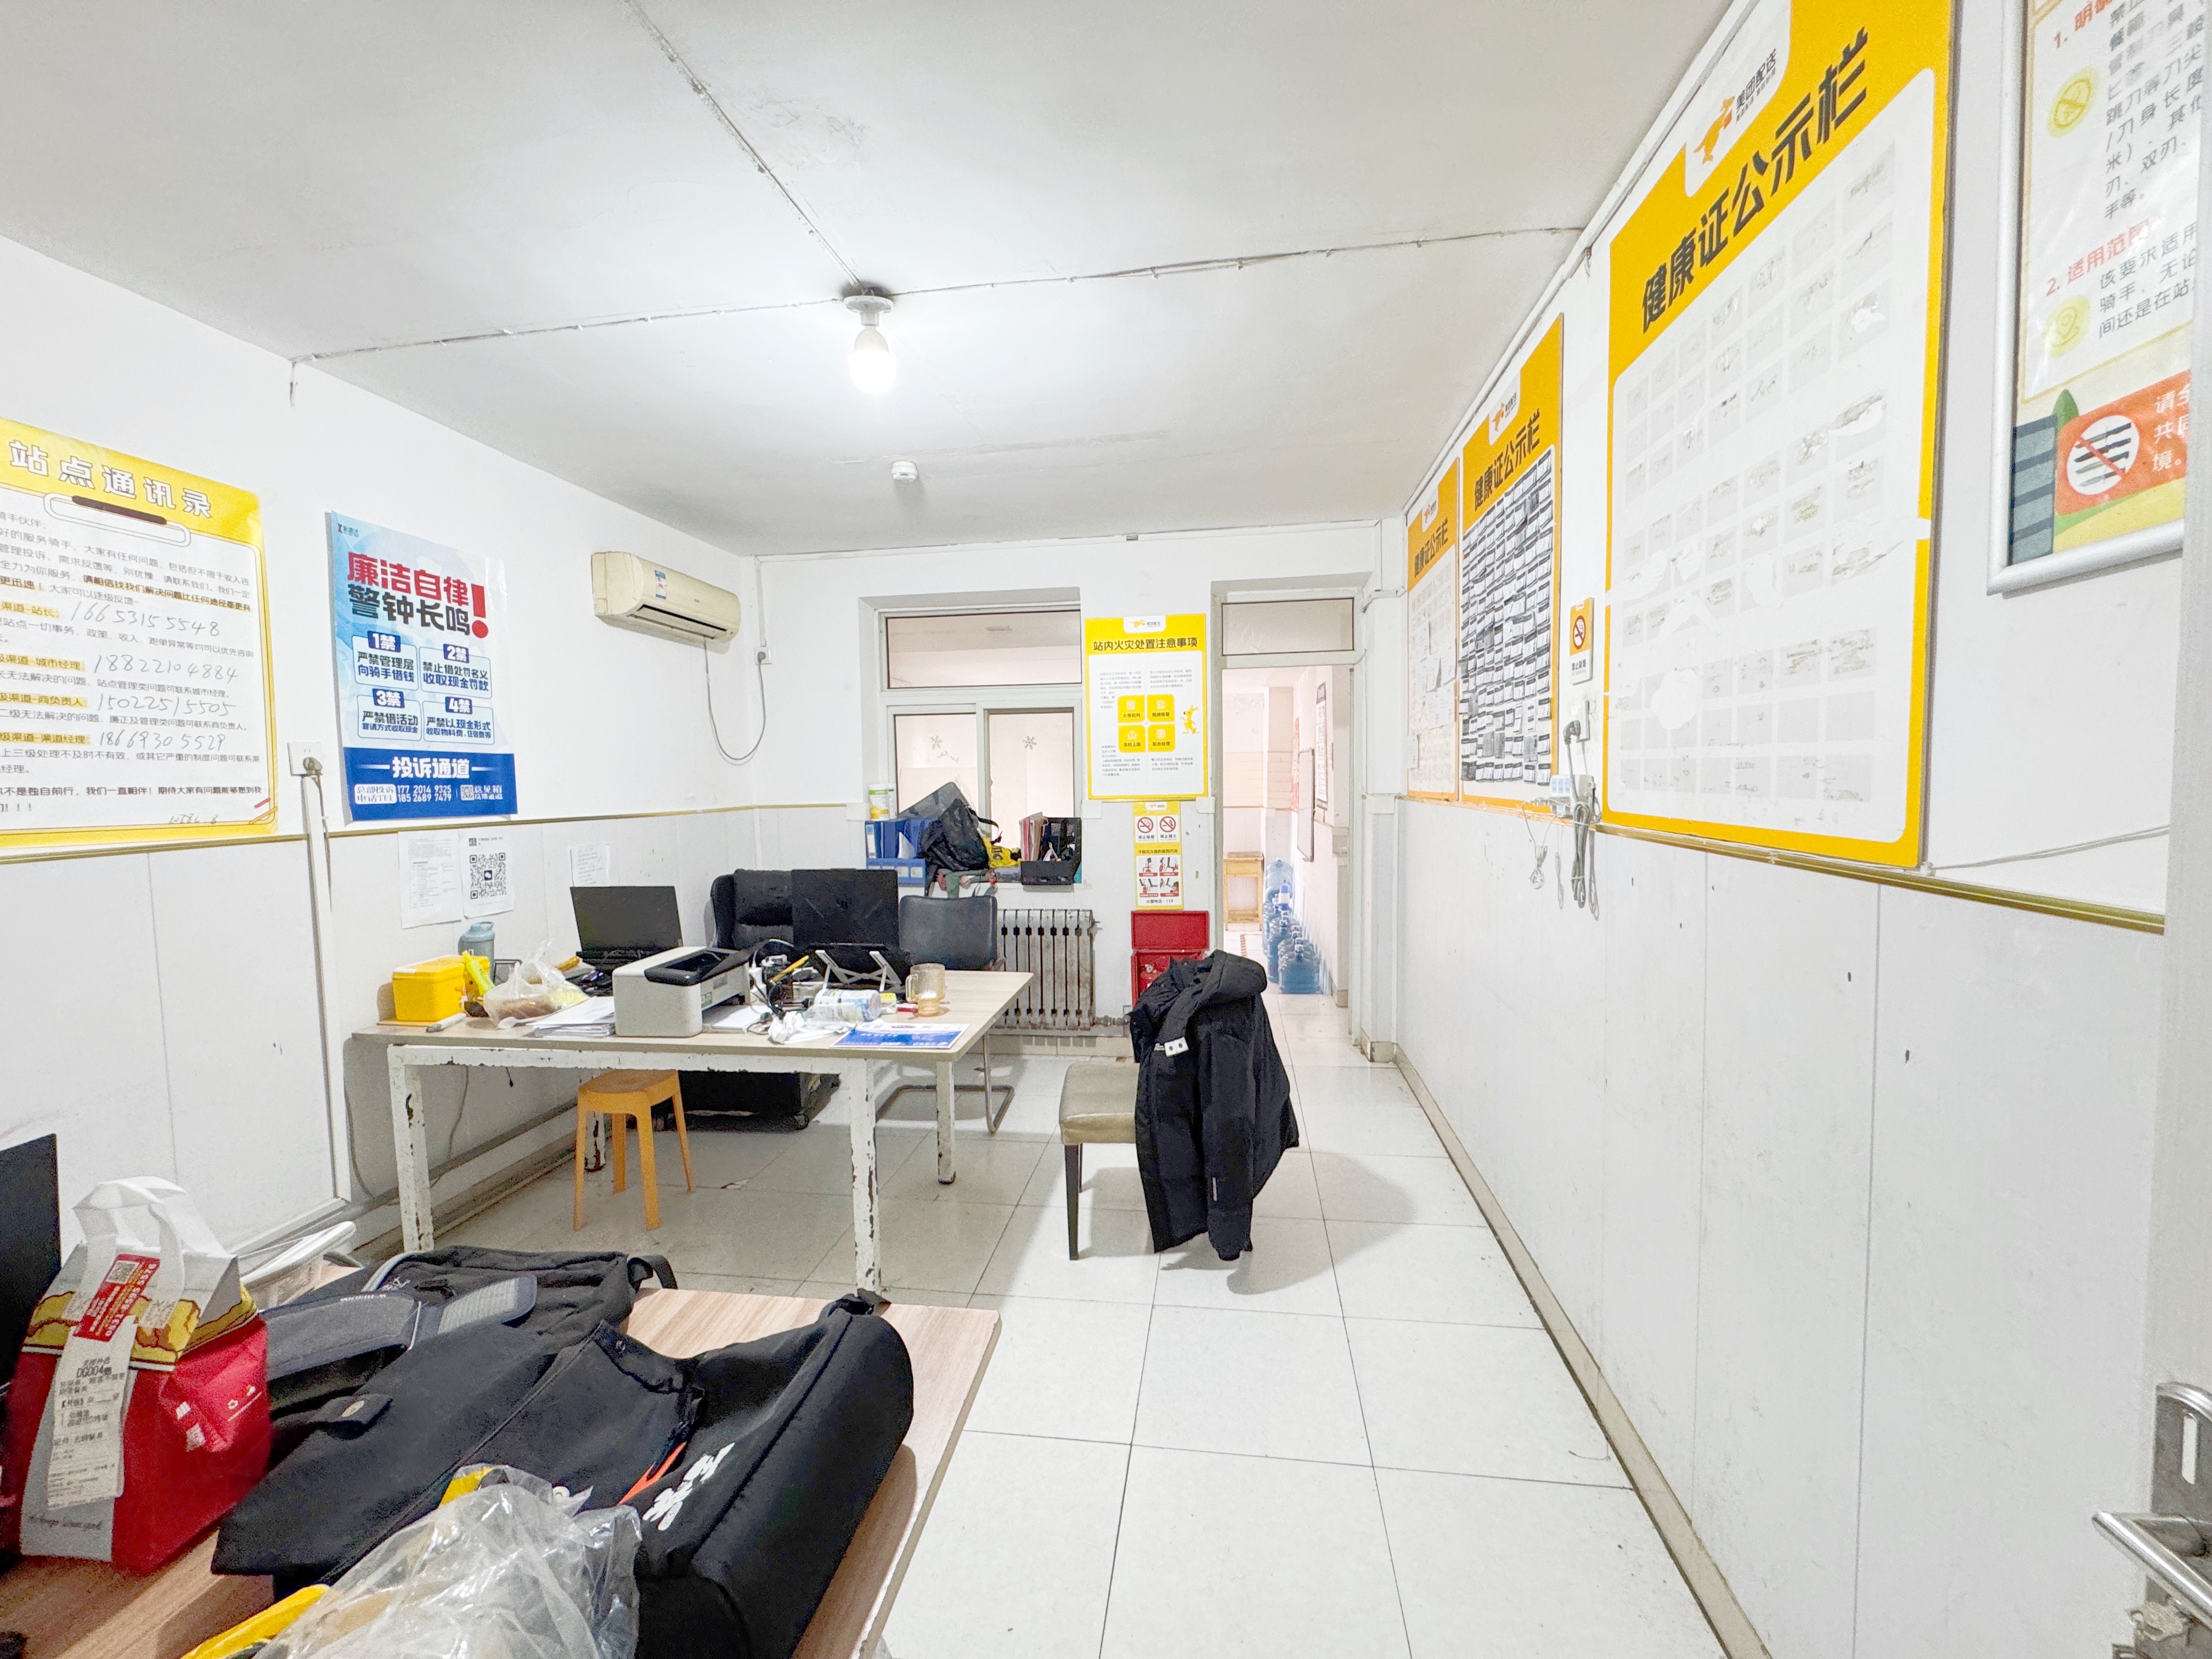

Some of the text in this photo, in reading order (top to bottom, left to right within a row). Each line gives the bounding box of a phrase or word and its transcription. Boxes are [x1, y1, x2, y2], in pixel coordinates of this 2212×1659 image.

[1736, 48, 1776, 114] 美团配送
[1643, 26, 1867, 334] 健康证公示栏
[1475, 408, 1540, 511] 健康证公示栏
[9, 441, 212, 518] 站点通讯录
[347, 551, 469, 606] 廉洁自律
[348, 583, 470, 636] 警钟长鸣
[372, 633, 396, 651] 1禁
[1093, 637, 1198, 651] 站内火灾处置注意事项
[357, 651, 414, 670] 严禁管理层
[447, 645, 467, 662] 2禁
[358, 664, 415, 682] 向骑手借钱
[423, 661, 489, 680] 禁止借处罚名义
[423, 673, 489, 692] 收取现金罚款
[376, 691, 401, 707] 3禁
[449, 698, 470, 713] 4禁
[362, 710, 418, 726] 严禁借活动
[427, 716, 491, 731] 严禁以现金形式
[392, 757, 470, 779] 投诉通道
[398, 786, 409, 794] 177
[435, 785, 452, 793] 9325
[413, 794, 431, 802] 2689
